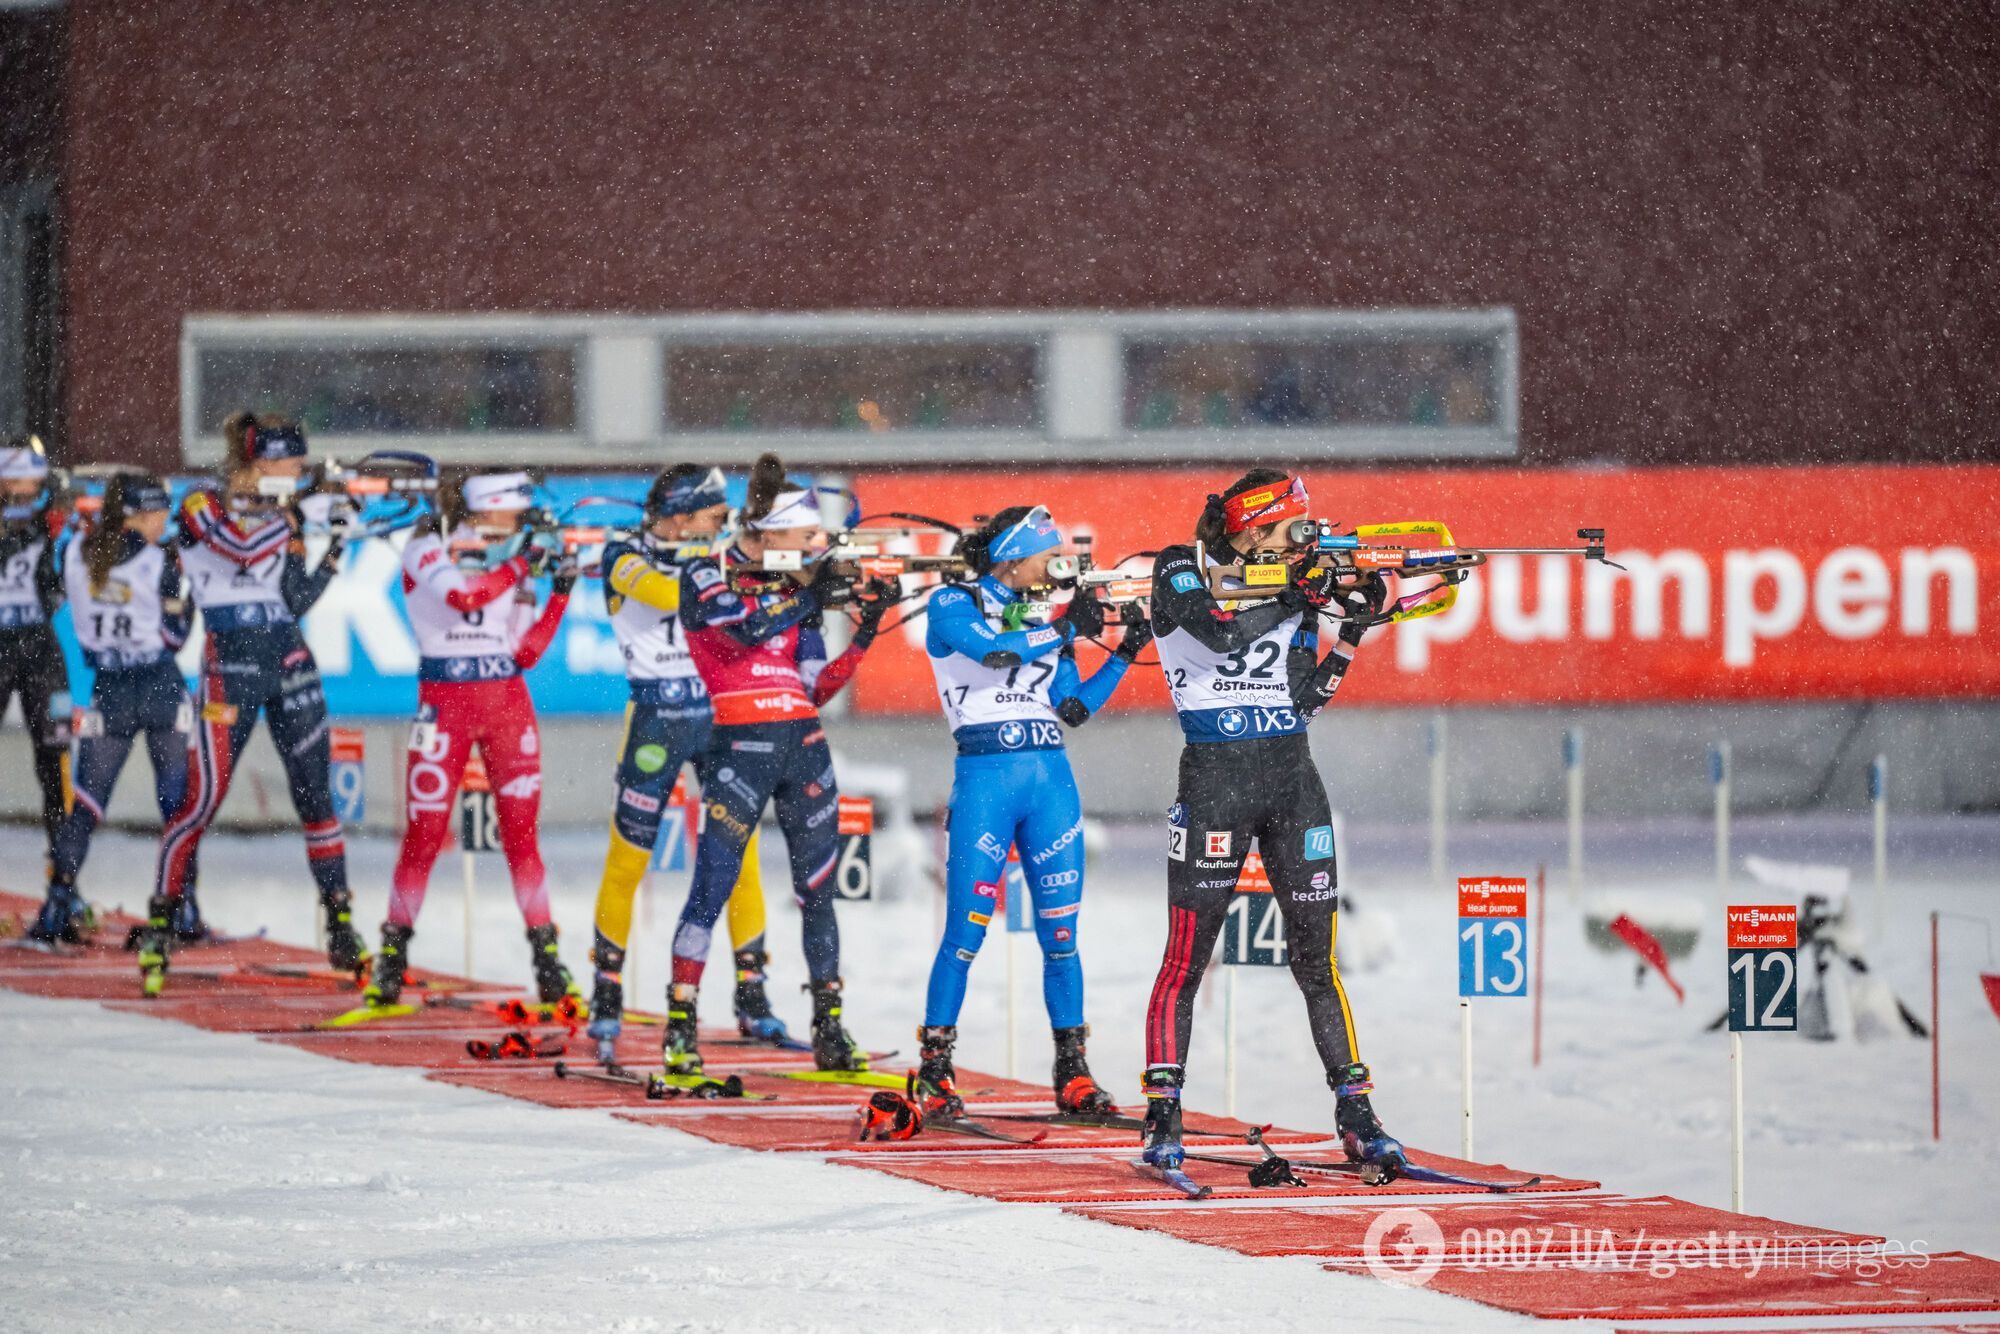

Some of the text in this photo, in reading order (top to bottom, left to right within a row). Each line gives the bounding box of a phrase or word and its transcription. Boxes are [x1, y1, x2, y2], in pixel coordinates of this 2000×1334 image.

[1356, 551, 1403, 563] VIESSMANN
[1258, 569, 1282, 577] LOTTO
[1216, 641, 1281, 679] 32
[943, 685, 970, 708] 17
[1253, 708, 1297, 733] iX3
[1310, 830, 1331, 854] TQ
[1195, 859, 1239, 869] Kaufland
[1460, 880, 1526, 898] VIESSMANN
[1467, 903, 1518, 914] Heat pumps
[1729, 909, 1796, 927] VIESSMANN
[1227, 895, 1288, 963] 14
[1737, 934, 1788, 945] Heat pumps
[1461, 921, 1524, 993] 13
[1730, 951, 1794, 1027] 12
